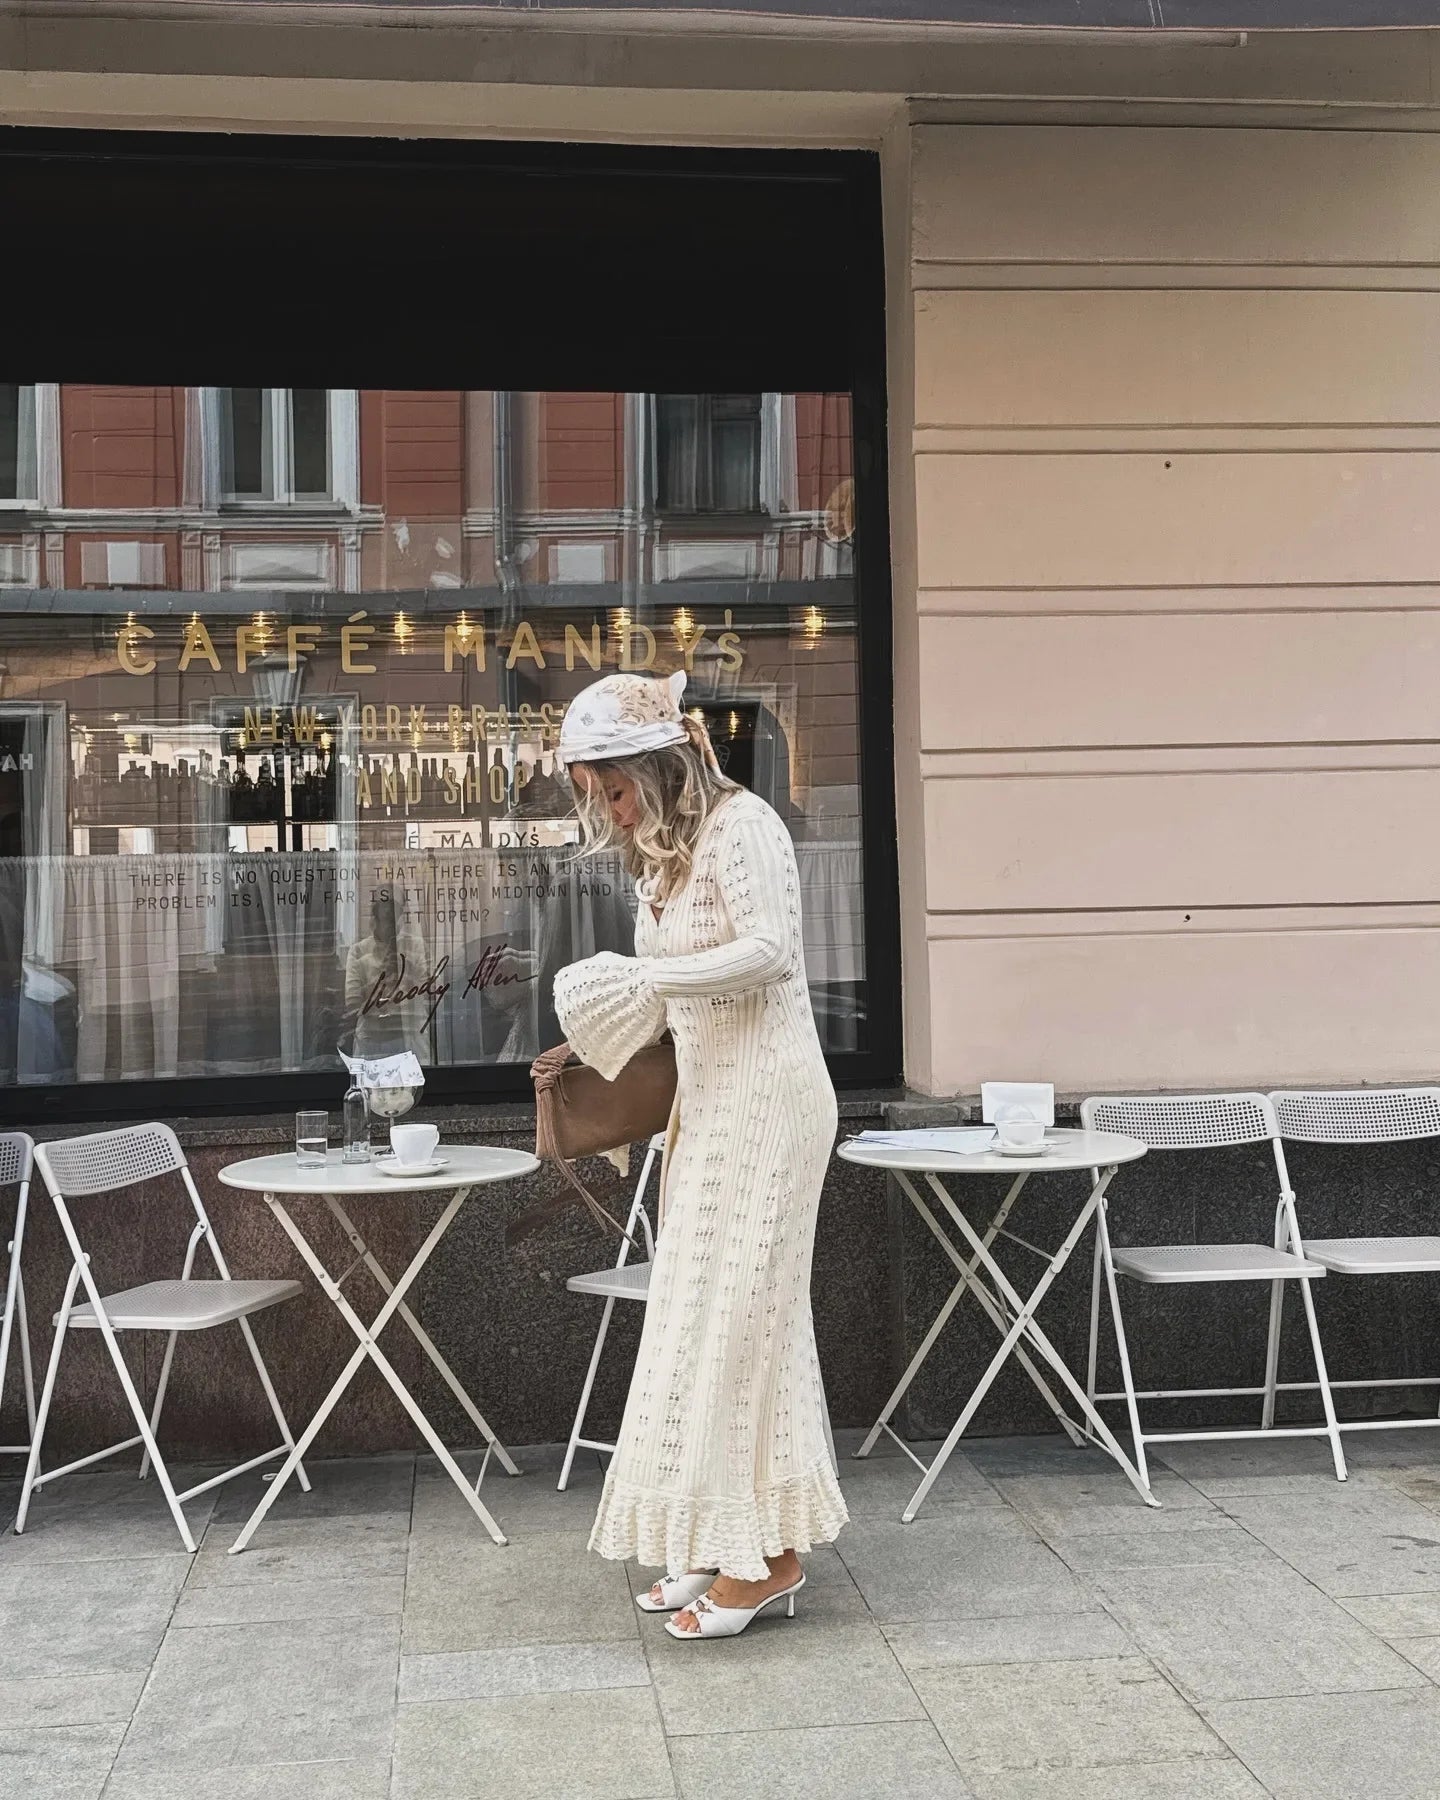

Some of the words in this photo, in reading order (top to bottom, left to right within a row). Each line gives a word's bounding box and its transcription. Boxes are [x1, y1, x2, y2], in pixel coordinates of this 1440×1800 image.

[117, 610, 377, 675] CAFFÉ
[244, 706, 317, 743] NEW
[337, 704, 426, 742] YORK
[448, 703, 571, 742] BRASS
[356, 767, 422, 806] AND
[444, 765, 528, 807] SHOP
[129, 873, 187, 888] THERE
[200, 871, 222, 886] IS
[235, 870, 257, 884] NO
[270, 867, 361, 885] QUESTION
[374, 865, 416, 881] THAT
[432, 864, 483, 878] THERE
[497, 862, 517, 877] IS
[529, 862, 550, 876] AN
[136, 894, 217, 910] PROBLEM
[231, 892, 262, 909] IS,
[277, 890, 310, 906] HOW
[323, 889, 356, 904] FAR
[369, 888, 390, 903] IS
[404, 887, 423, 902] IT
[437, 886, 479, 900] FROM
[491, 884, 567, 899] MIDTOWN
[581, 883, 612, 897] AND
[404, 910, 423, 925] IT
[437, 908, 490, 924] OPEN?
